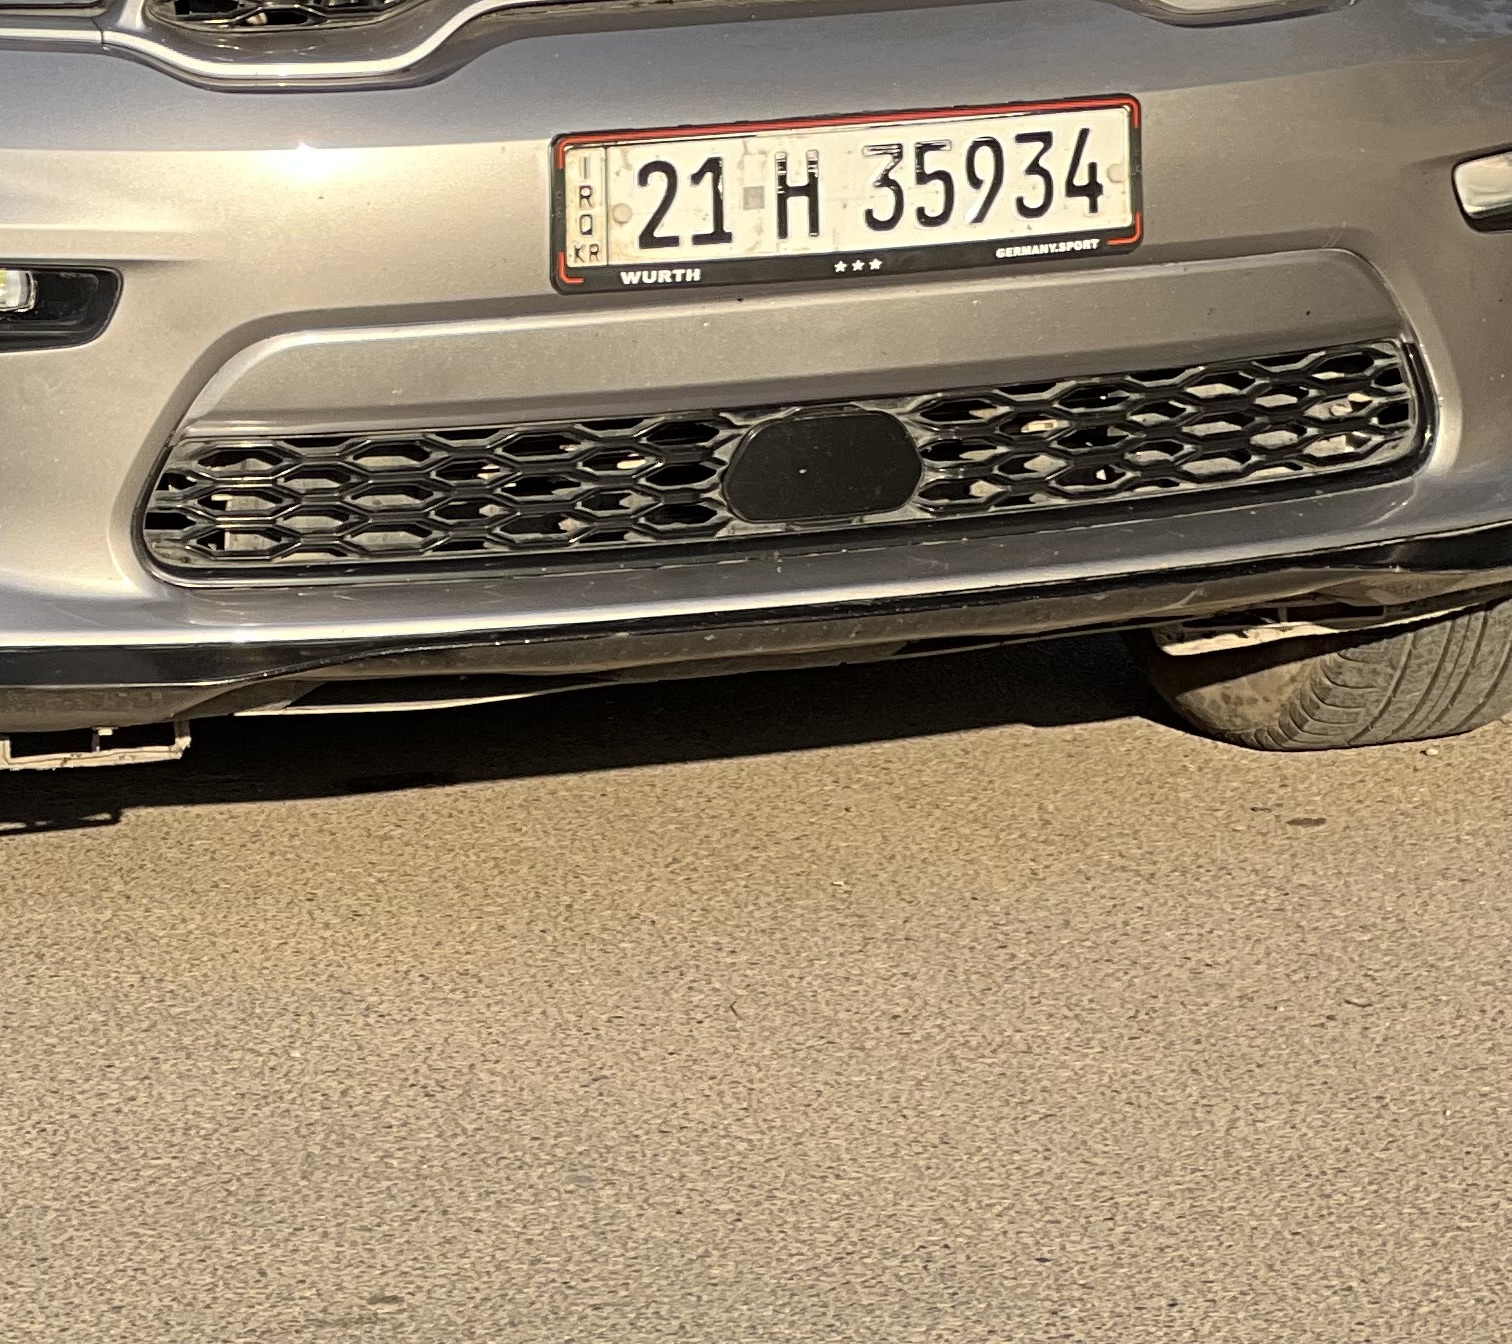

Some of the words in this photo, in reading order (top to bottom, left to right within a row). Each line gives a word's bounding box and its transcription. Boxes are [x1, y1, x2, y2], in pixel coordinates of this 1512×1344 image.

[638, 156, 732, 250] 21
[775, 148, 820, 240] H
[861, 127, 1105, 234] 35934
[573, 243, 600, 264] KR
[620, 268, 701, 285] WURTH
